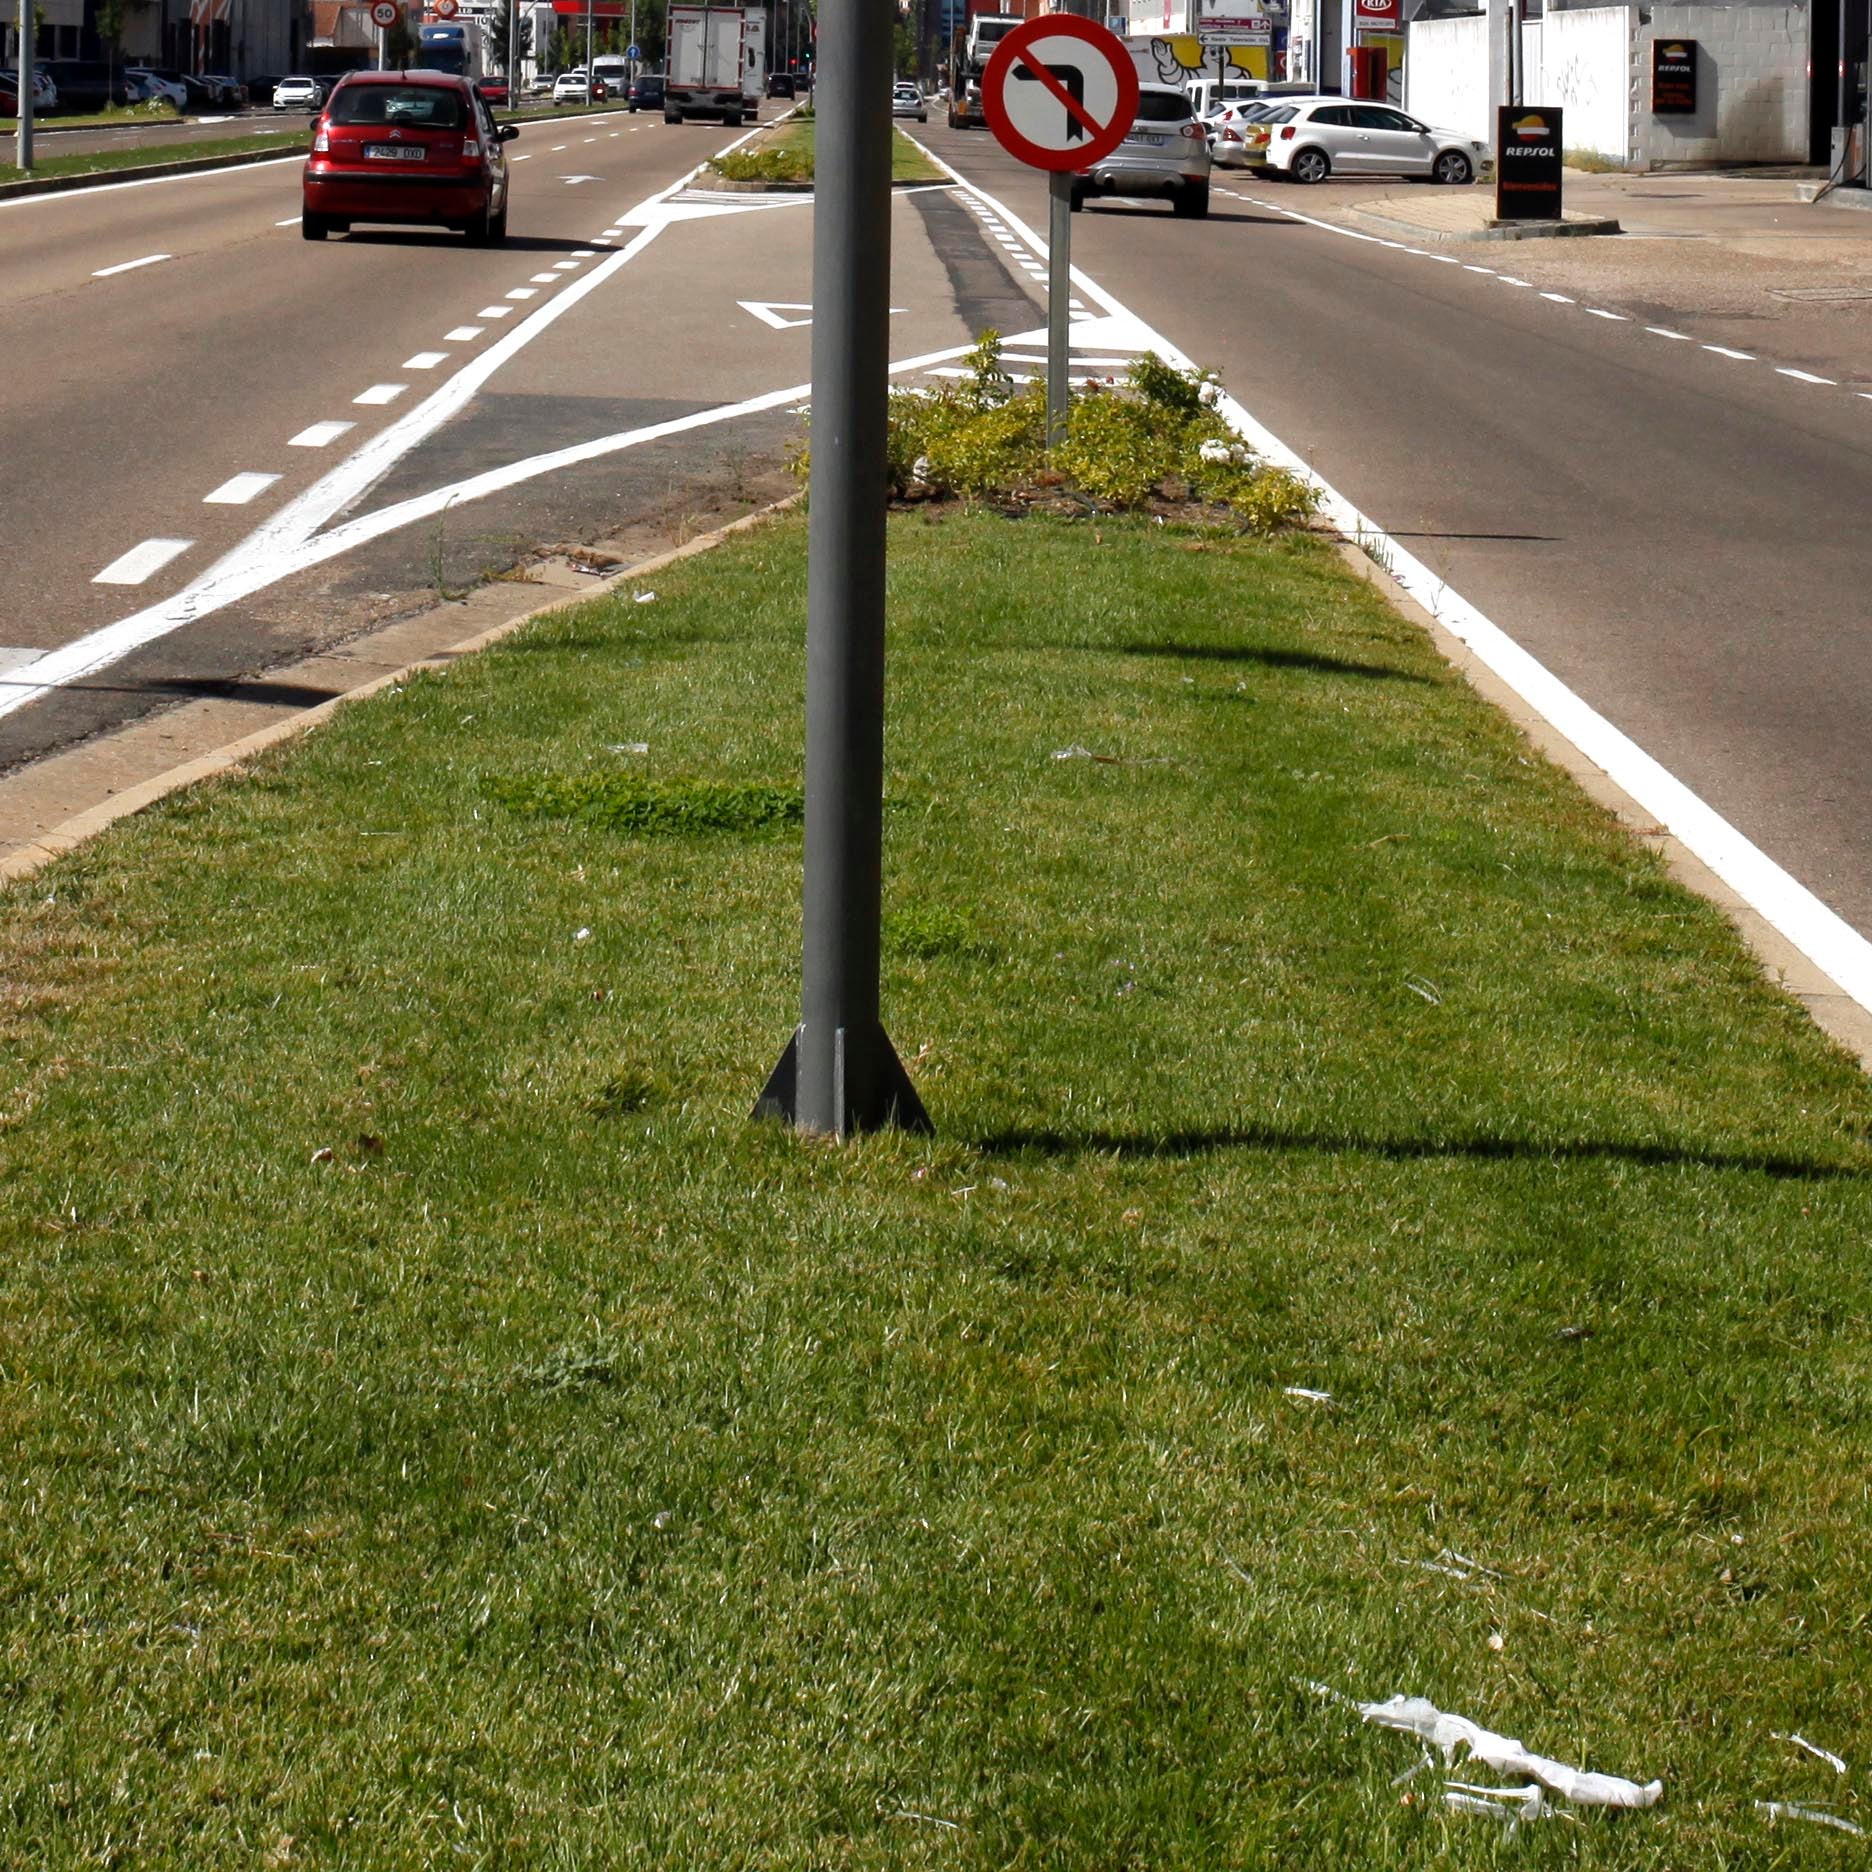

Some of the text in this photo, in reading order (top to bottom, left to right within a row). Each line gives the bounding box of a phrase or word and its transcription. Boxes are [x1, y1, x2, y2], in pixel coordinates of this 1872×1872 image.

[1367, 0, 1387, 7] KIA
[377, 8, 392, 18] 50
[1657, 64, 1692, 73] REPSOL
[1505, 146, 1556, 157] REPSOL
